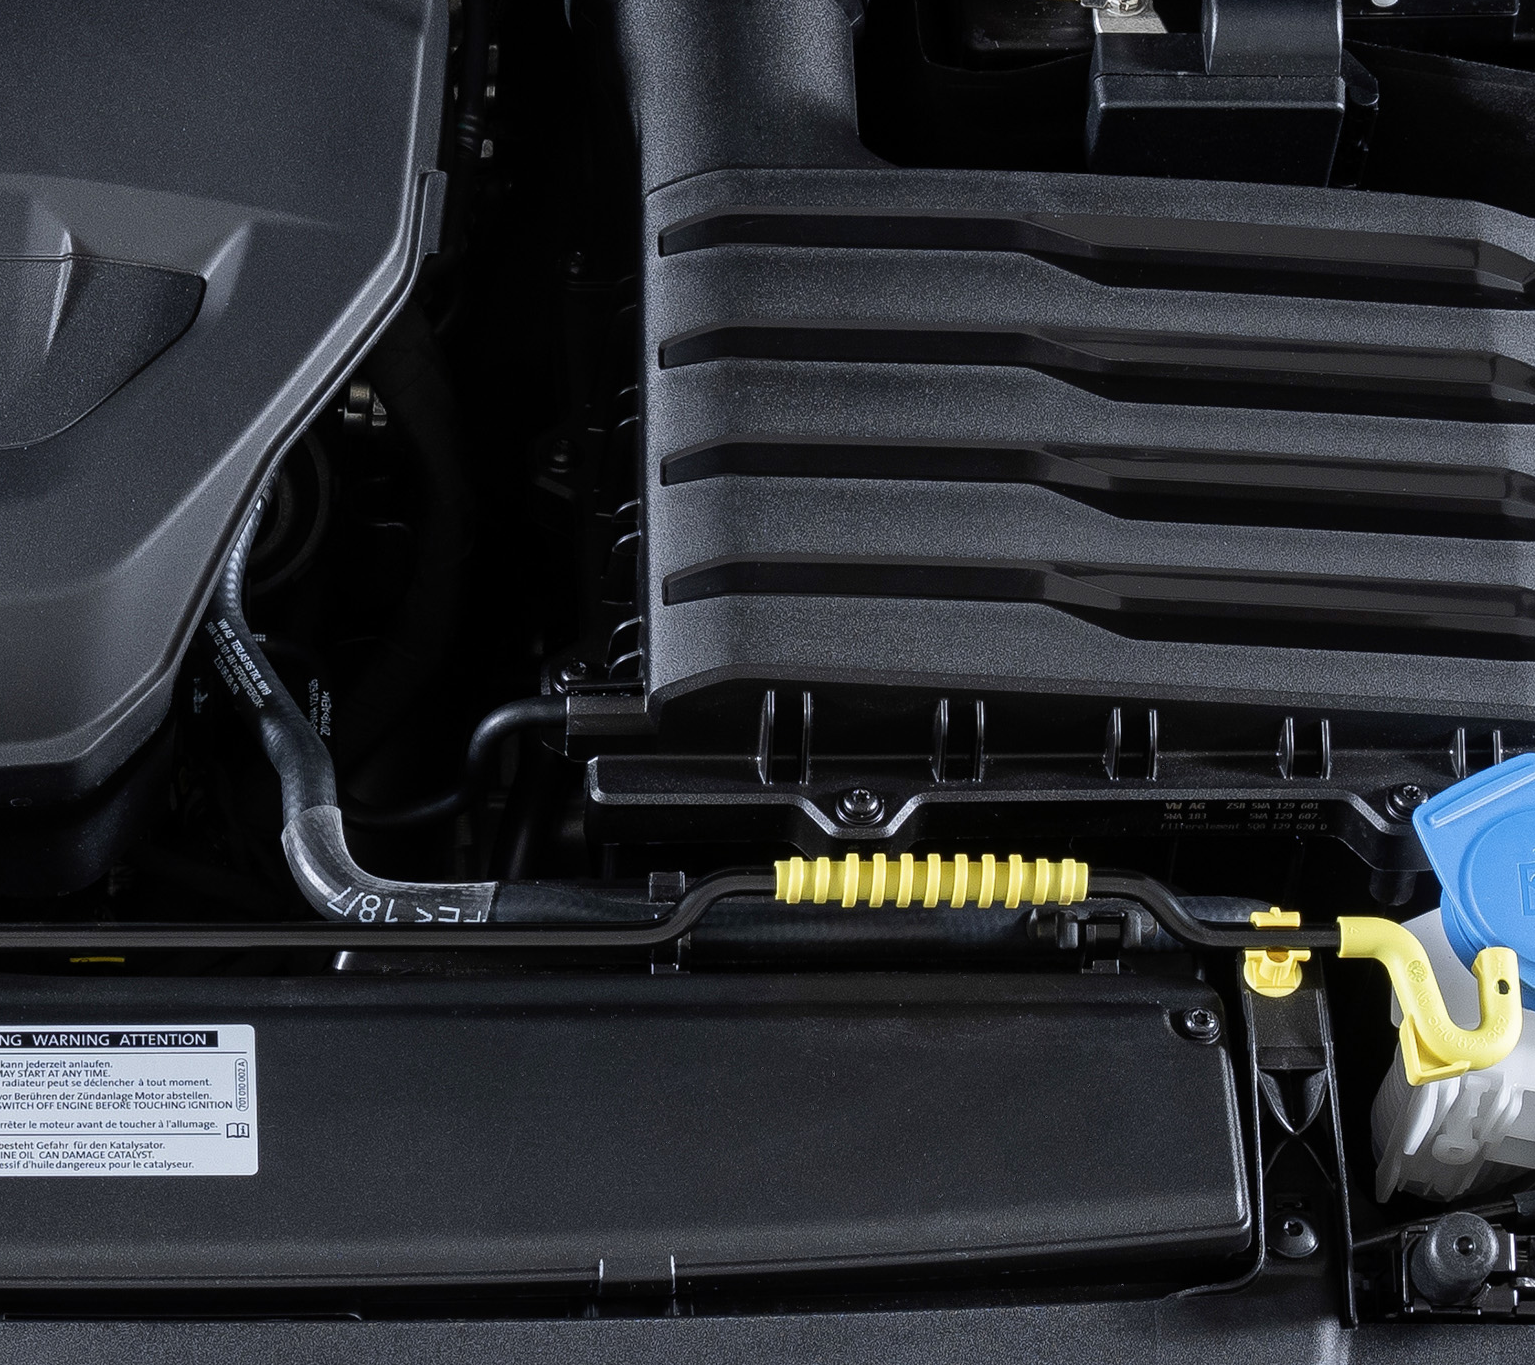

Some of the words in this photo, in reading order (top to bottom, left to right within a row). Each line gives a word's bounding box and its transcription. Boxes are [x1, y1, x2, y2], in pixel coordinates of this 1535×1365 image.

[32, 1034, 110, 1047] WARNING
[119, 1033, 207, 1046] ATTENTION
[0, 1060, 24, 1069] kann
[26, 1060, 67, 1071] jederzeit
[68, 1060, 113, 1069] anlaufen.
[17, 1069, 46, 1078] START
[48, 1069, 60, 1078] AT
[62, 1069, 83, 1078] ANY
[84, 1069, 111, 1078] TIME.
[2, 1079, 45, 1088] radiateur
[47, 1079, 69, 1088] peut
[71, 1079, 82, 1087] se
[83, 1078, 135, 1087] déclencher
[138, 1078, 144, 1087] à
[146, 1078, 167, 1087] tout
[169, 1078, 212, 1087] moment.
[14, 1092, 58, 1101] Berühren
[59, 1092, 75, 1101] der
[77, 1092, 133, 1102] Zündanlage
[135, 1092, 165, 1101] Motor
[166, 1092, 212, 1101] abstellen.
[36, 1101, 54, 1110] OFF
[56, 1101, 93, 1110] ENGINE
[95, 1101, 131, 1110] BEFORE
[133, 1101, 186, 1110] TOUCHING
[188, 1101, 233, 1109] IGNITION
[29, 1121, 37, 1130] le
[39, 1121, 75, 1129] moteur
[76, 1121, 103, 1129] avant
[105, 1120, 118, 1129] de
[119, 1120, 156, 1129] toucher
[158, 1120, 164, 1129] à
[166, 1120, 218, 1129] l'allumage.
[36, 1141, 69, 1150] Gefahr
[73, 1141, 88, 1150] für
[89, 1141, 108, 1150] den
[110, 1141, 166, 1150] Katalysator.
[19, 1151, 34, 1160] OIL
[39, 1151, 60, 1160] CAN
[62, 1151, 105, 1160] DAMAGE
[107, 1151, 155, 1159] CATALYST.
[22, 1161, 55, 1169] d'huile
[55, 1160, 107, 1169] dangereux
[108, 1160, 131, 1169] pour
[133, 1160, 142, 1169] le
[143, 1160, 194, 1169] catalyseur.
